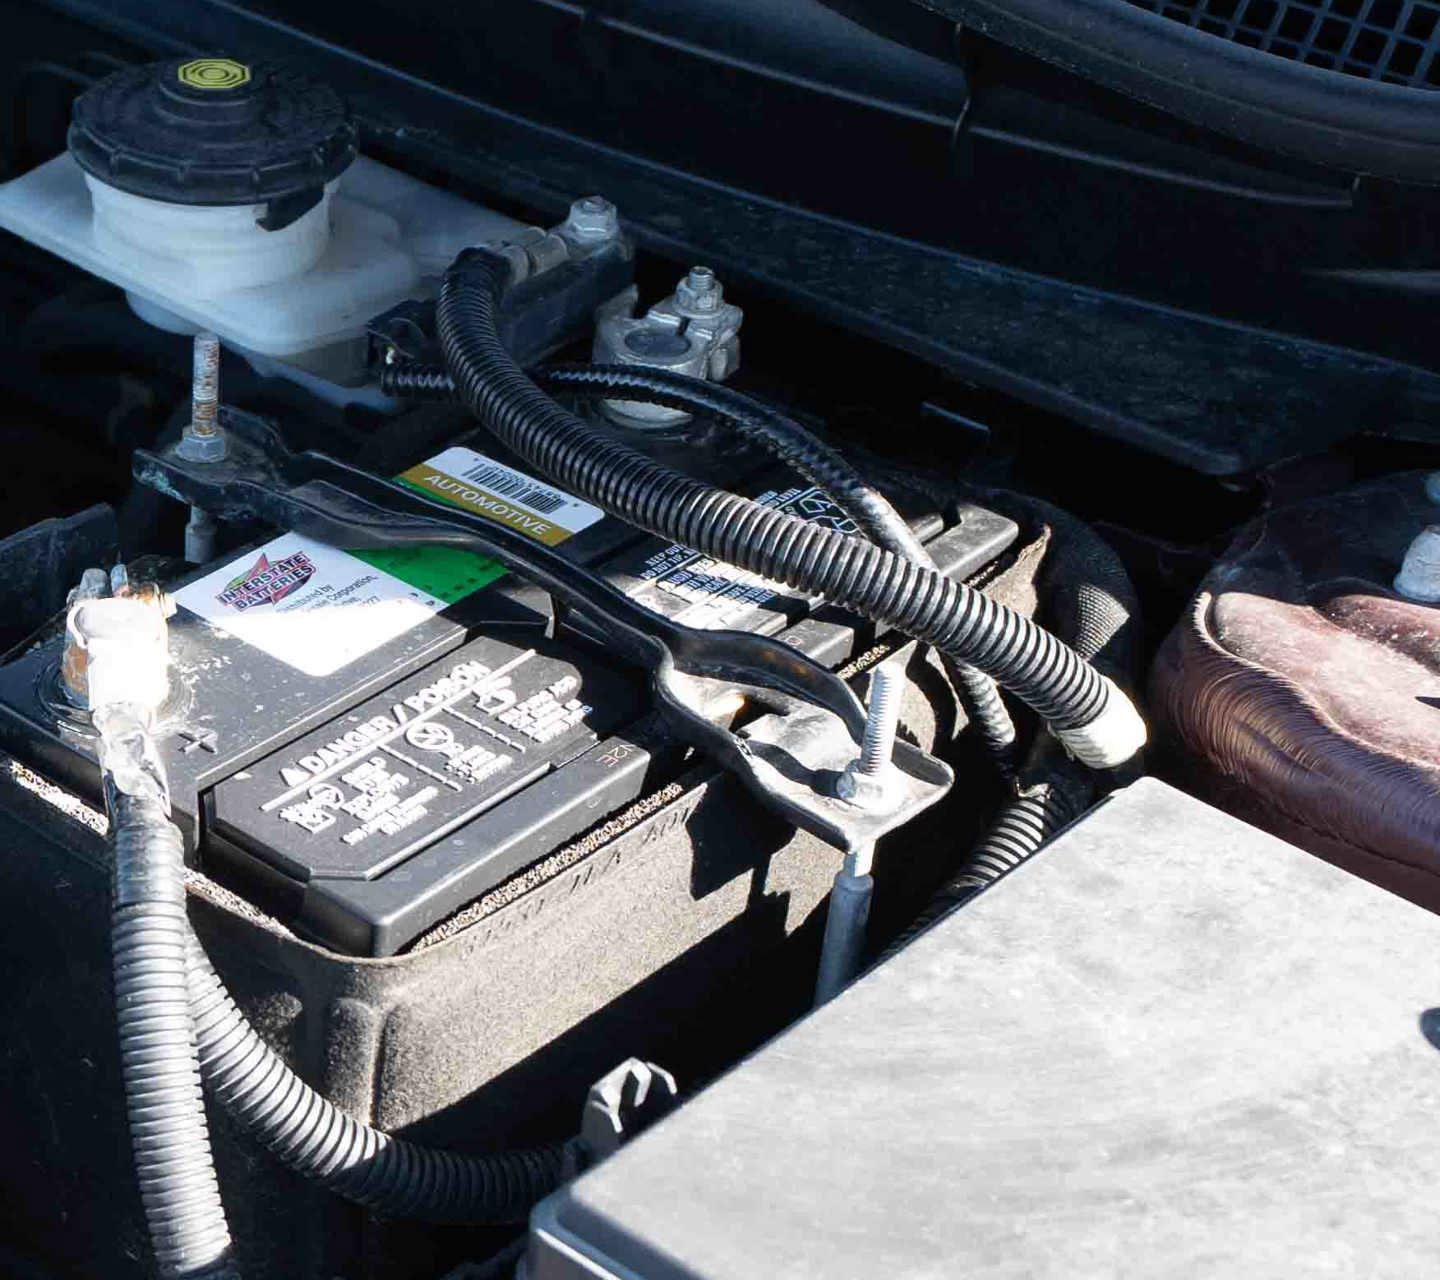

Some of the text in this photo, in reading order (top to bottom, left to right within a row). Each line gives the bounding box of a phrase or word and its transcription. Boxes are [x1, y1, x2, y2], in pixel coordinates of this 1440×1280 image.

[424, 475, 551, 535] AUTOMOTIVE
[219, 552, 309, 604] INTERSTATE
[234, 564, 315, 610] BATTERIES
[297, 716, 393, 771] DANGER
[404, 660, 491, 714] POISON
